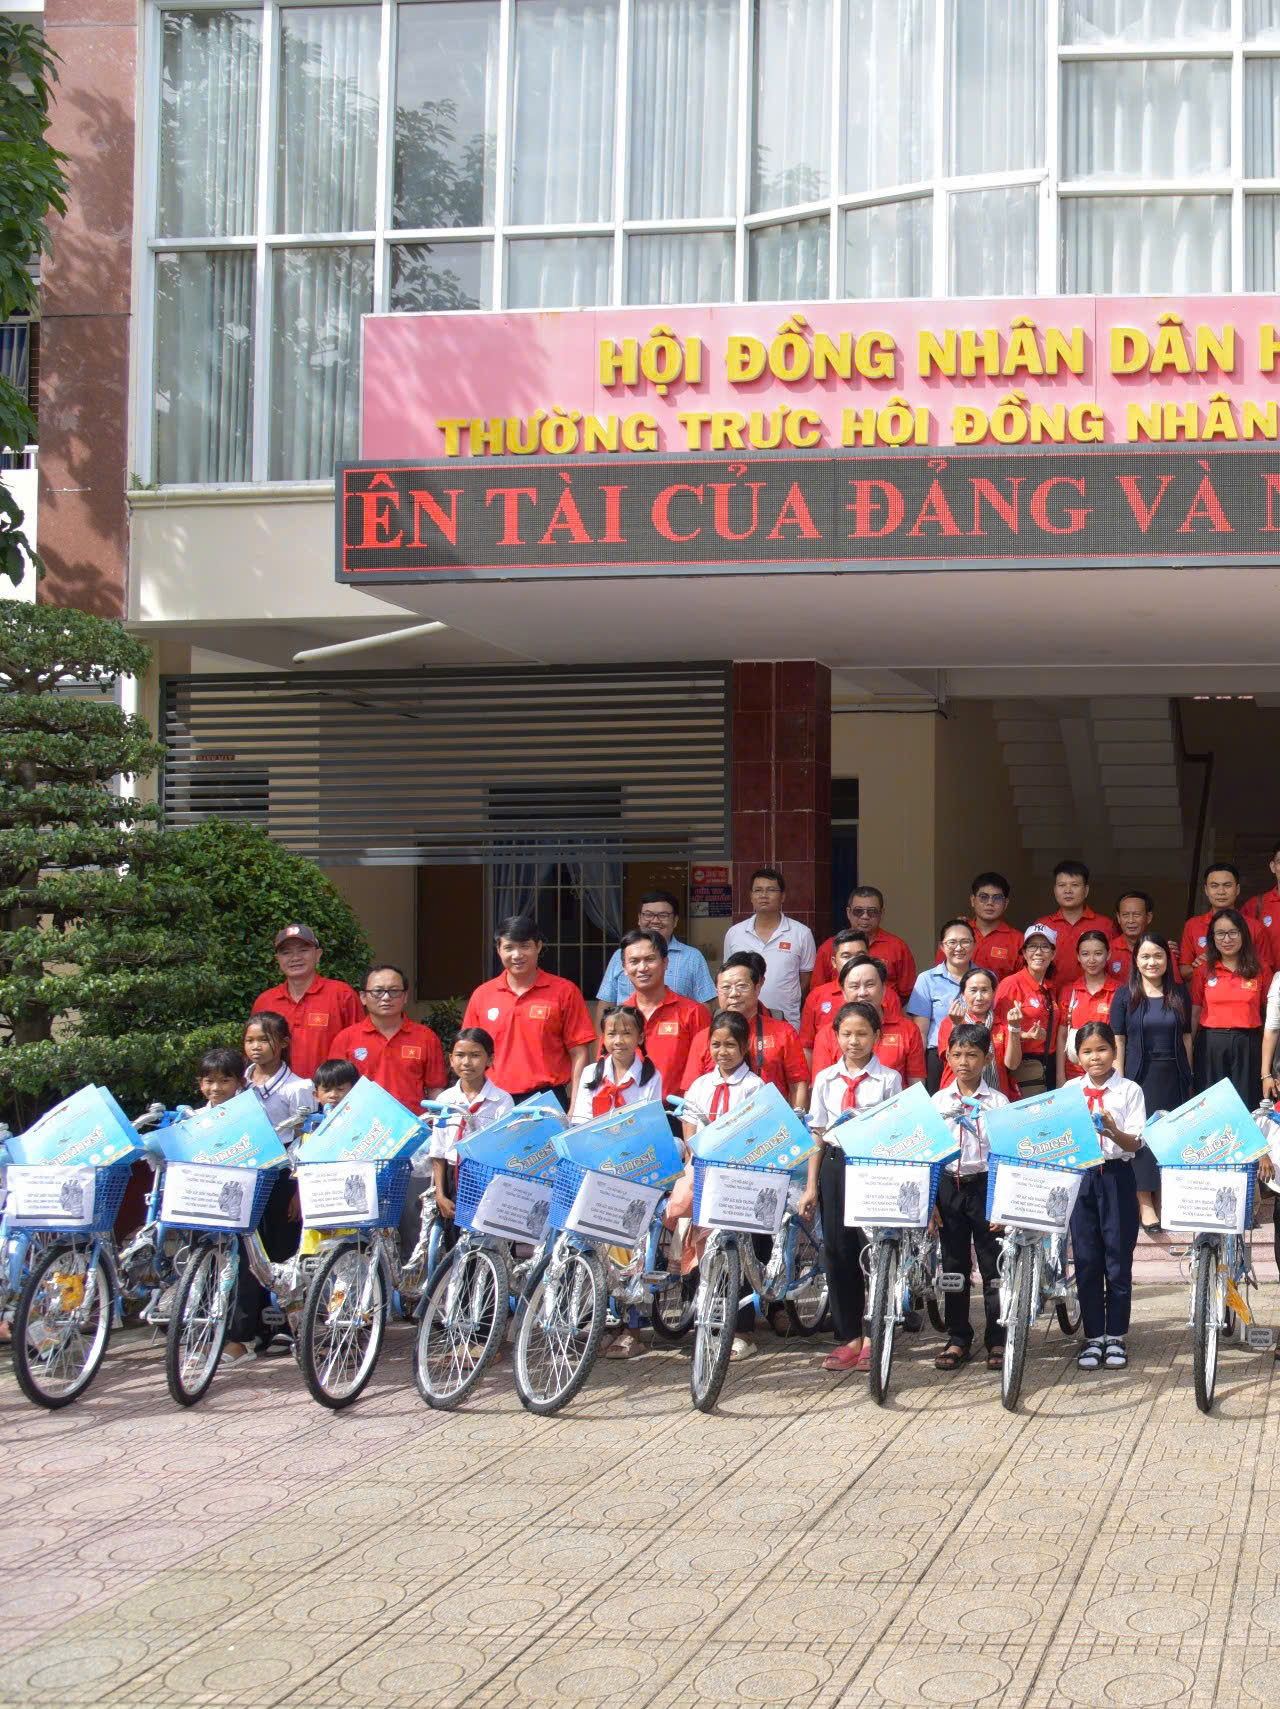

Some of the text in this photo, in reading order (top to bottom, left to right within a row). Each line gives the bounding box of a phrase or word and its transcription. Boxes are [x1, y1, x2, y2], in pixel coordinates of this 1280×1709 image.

[599, 324, 701, 394] HỘI
[725, 314, 895, 383] ĐỒNG
[917, 316, 1085, 378] NHÂN
[1110, 313, 1236, 376] DÂN
[436, 406, 658, 456] THƯỜNG
[840, 396, 930, 448] HỘI
[950, 389, 1106, 445] ĐỒNG
[1126, 391, 1279, 442] NHÂN
[344, 472, 465, 549] ÊN
[485, 470, 629, 546] TÀI
[650, 463, 823, 542] CỦA
[847, 459, 1093, 537] ĐẢNG
[1116, 459, 1236, 533] VÀ
[1017, 1128, 1075, 1158] Sanest
